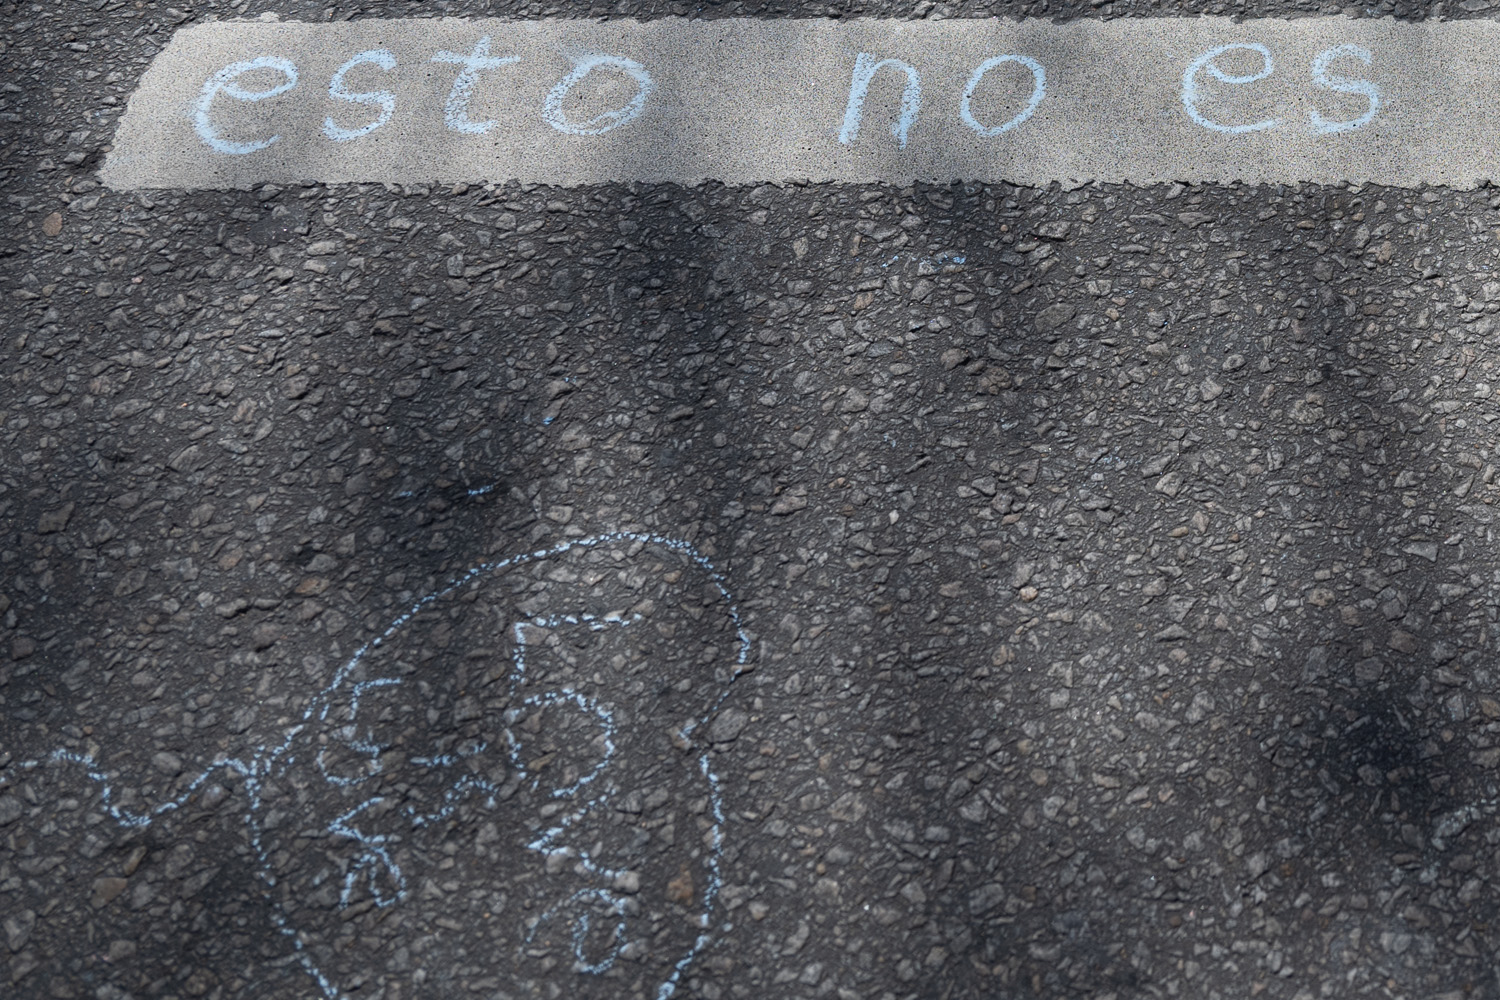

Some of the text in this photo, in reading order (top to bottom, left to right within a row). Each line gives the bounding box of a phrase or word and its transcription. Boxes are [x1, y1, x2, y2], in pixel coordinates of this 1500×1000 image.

[195, 35, 655, 155] esto
[838, 50, 1047, 148] no
[1180, 42, 1382, 135] es
